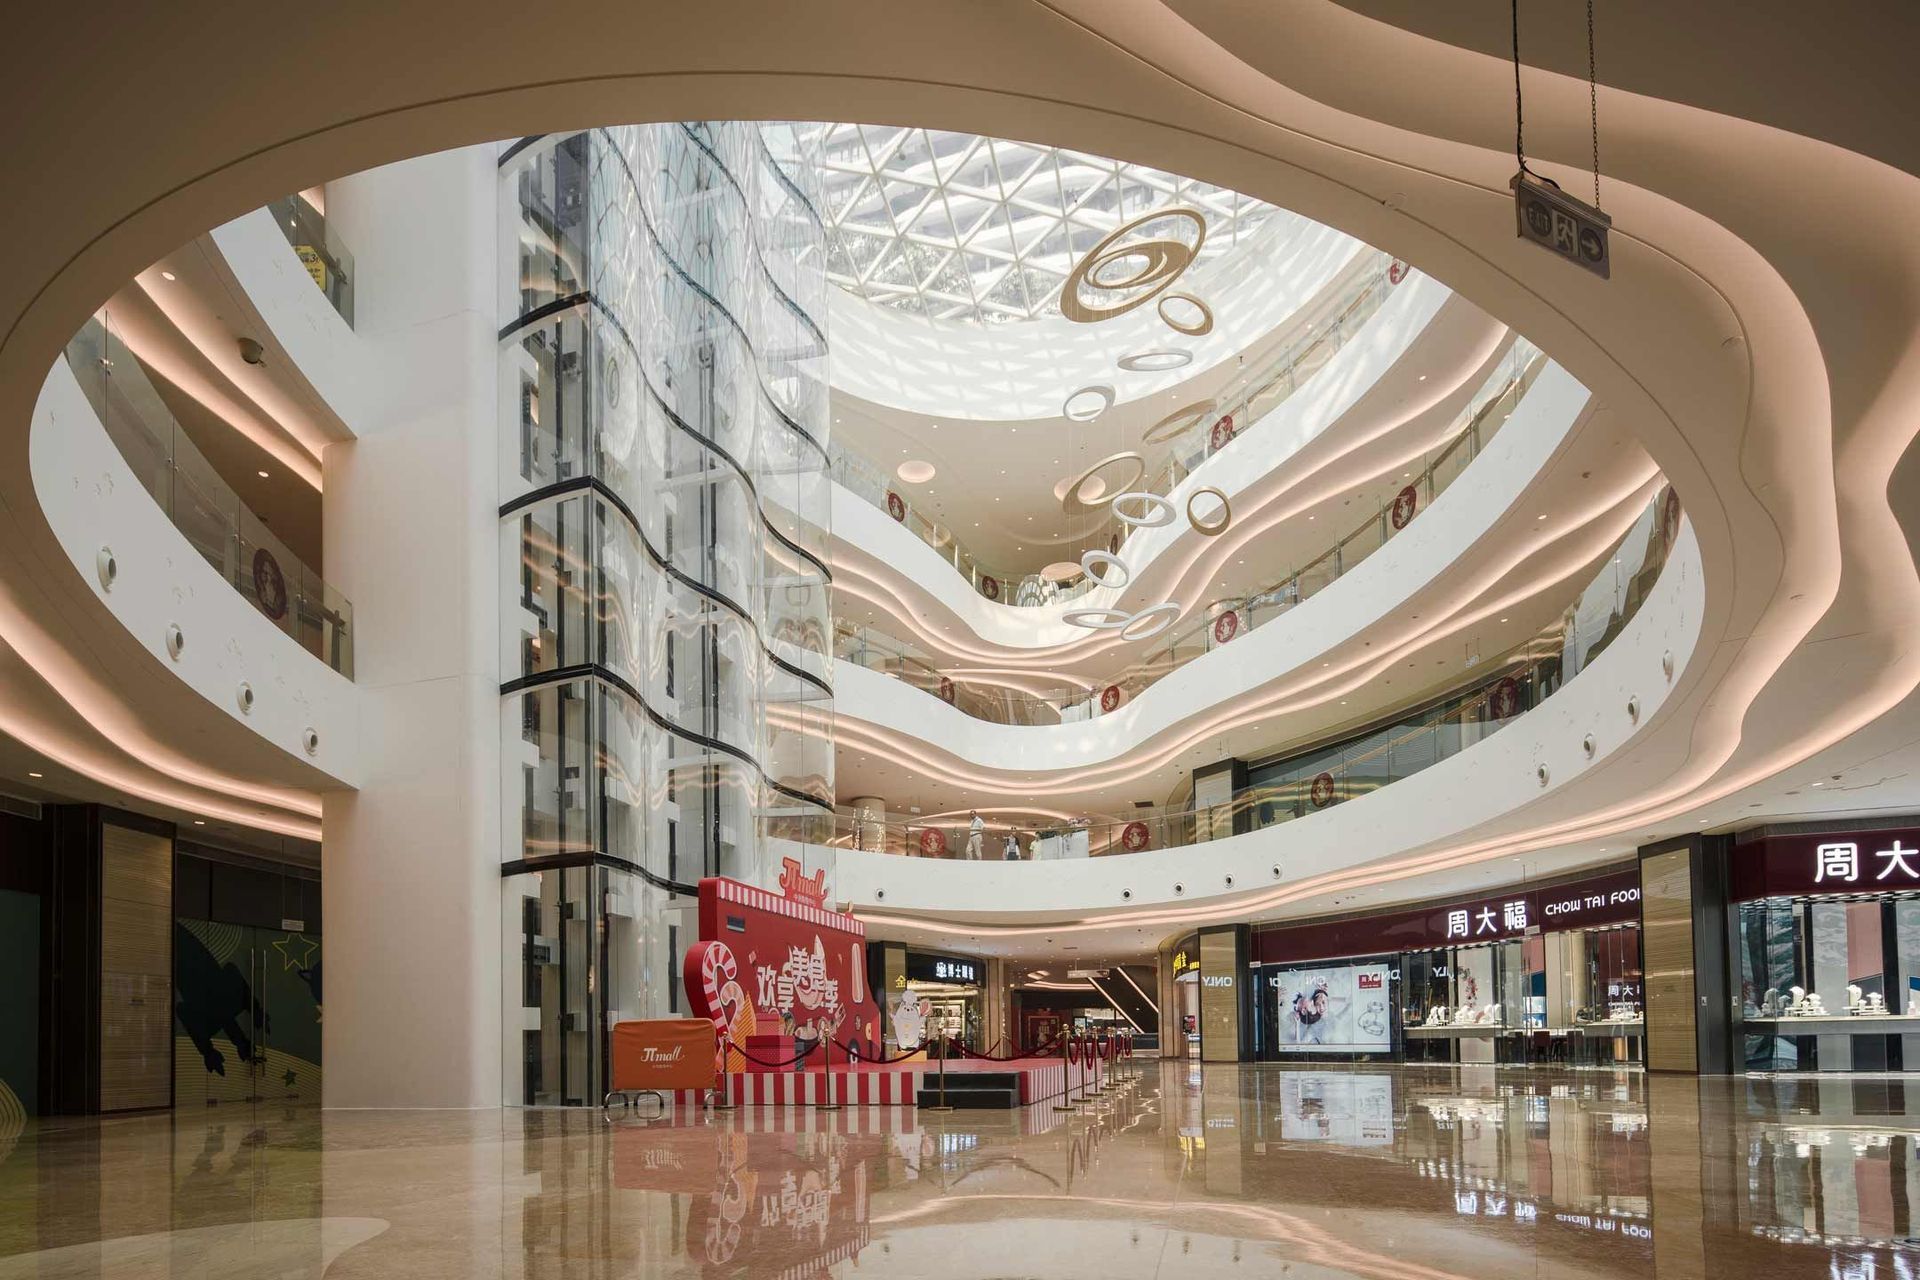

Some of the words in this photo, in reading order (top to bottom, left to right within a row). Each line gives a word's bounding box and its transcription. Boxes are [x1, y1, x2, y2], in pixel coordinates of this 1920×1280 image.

[1815, 840, 1919, 883] 周大
[1545, 899, 1581, 915] CHOW
[1584, 895, 1605, 909] TAI
[1611, 888, 1640, 904] FOO
[1447, 901, 1527, 938] 周大福
[1608, 985, 1640, 997] 周大
